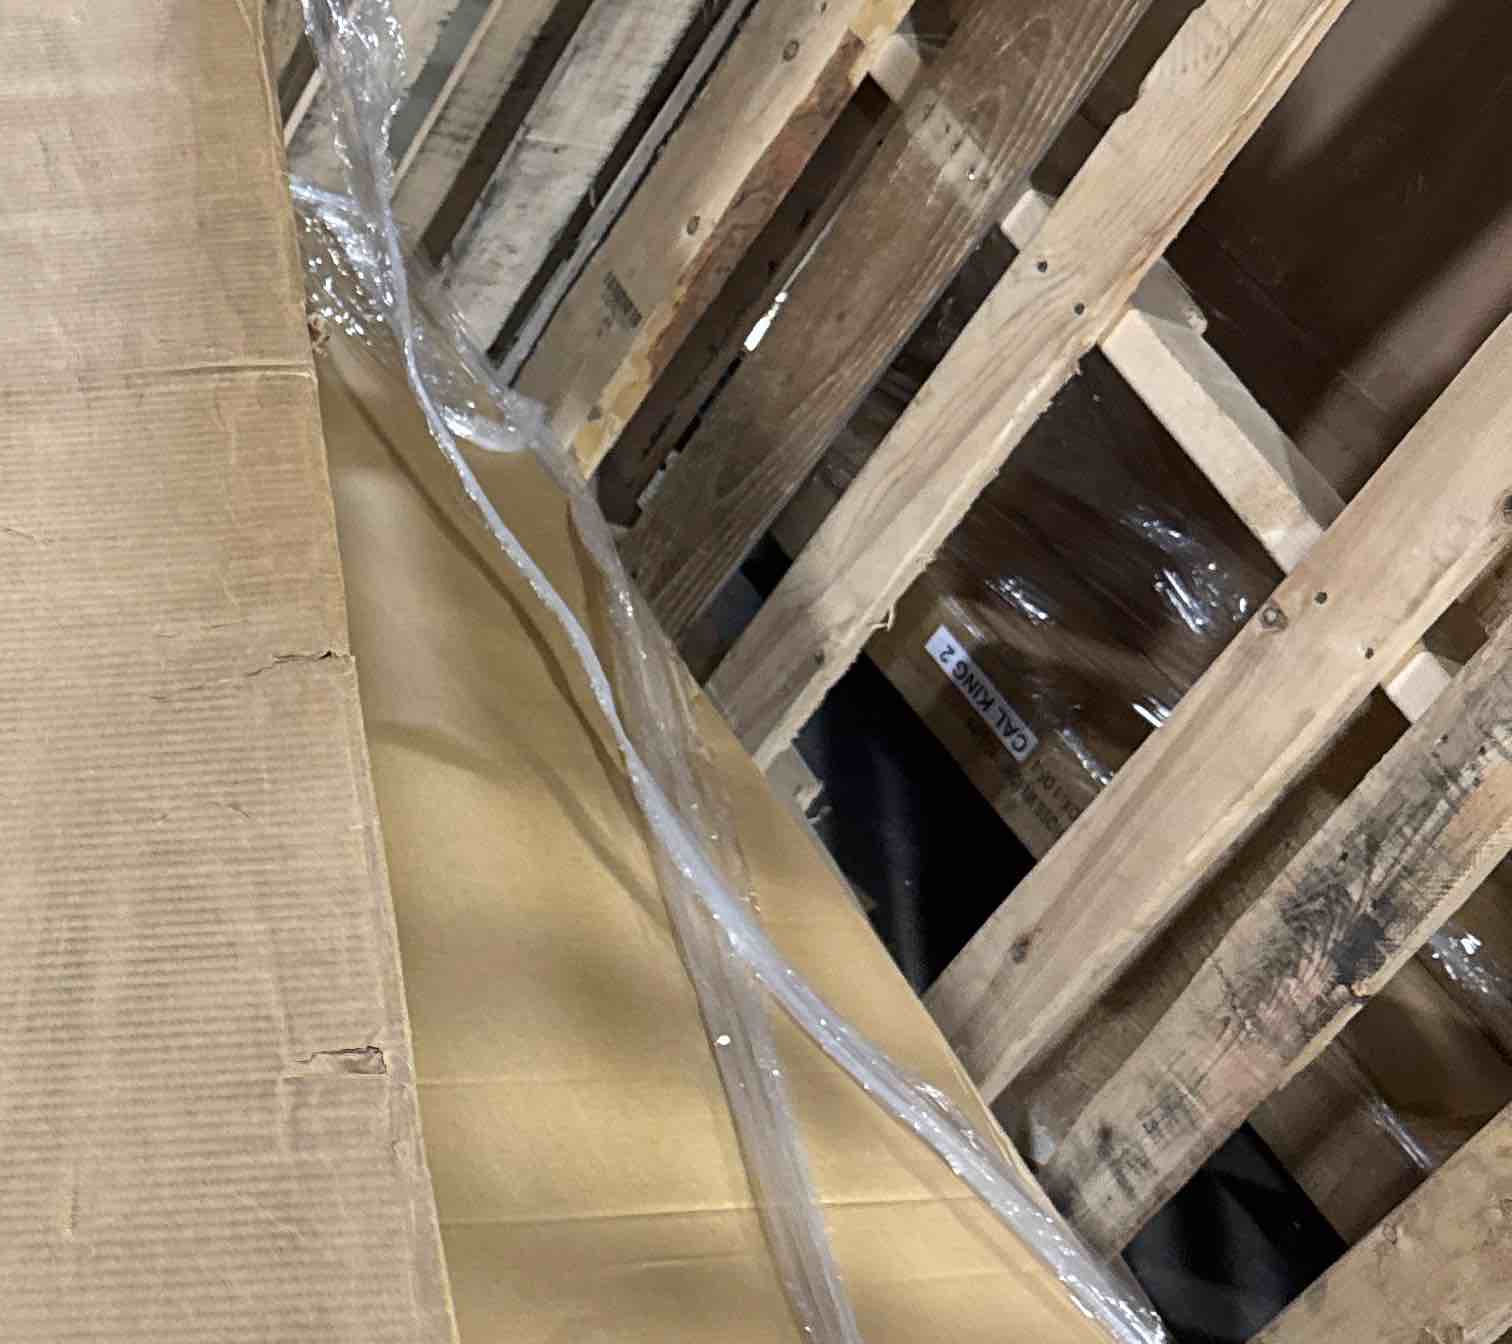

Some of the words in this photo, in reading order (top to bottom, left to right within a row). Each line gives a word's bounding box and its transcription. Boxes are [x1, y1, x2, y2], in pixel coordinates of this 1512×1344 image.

[939, 645, 955, 663] 2
[952, 660, 995, 713] KING
[995, 709, 1027, 753] CAL
